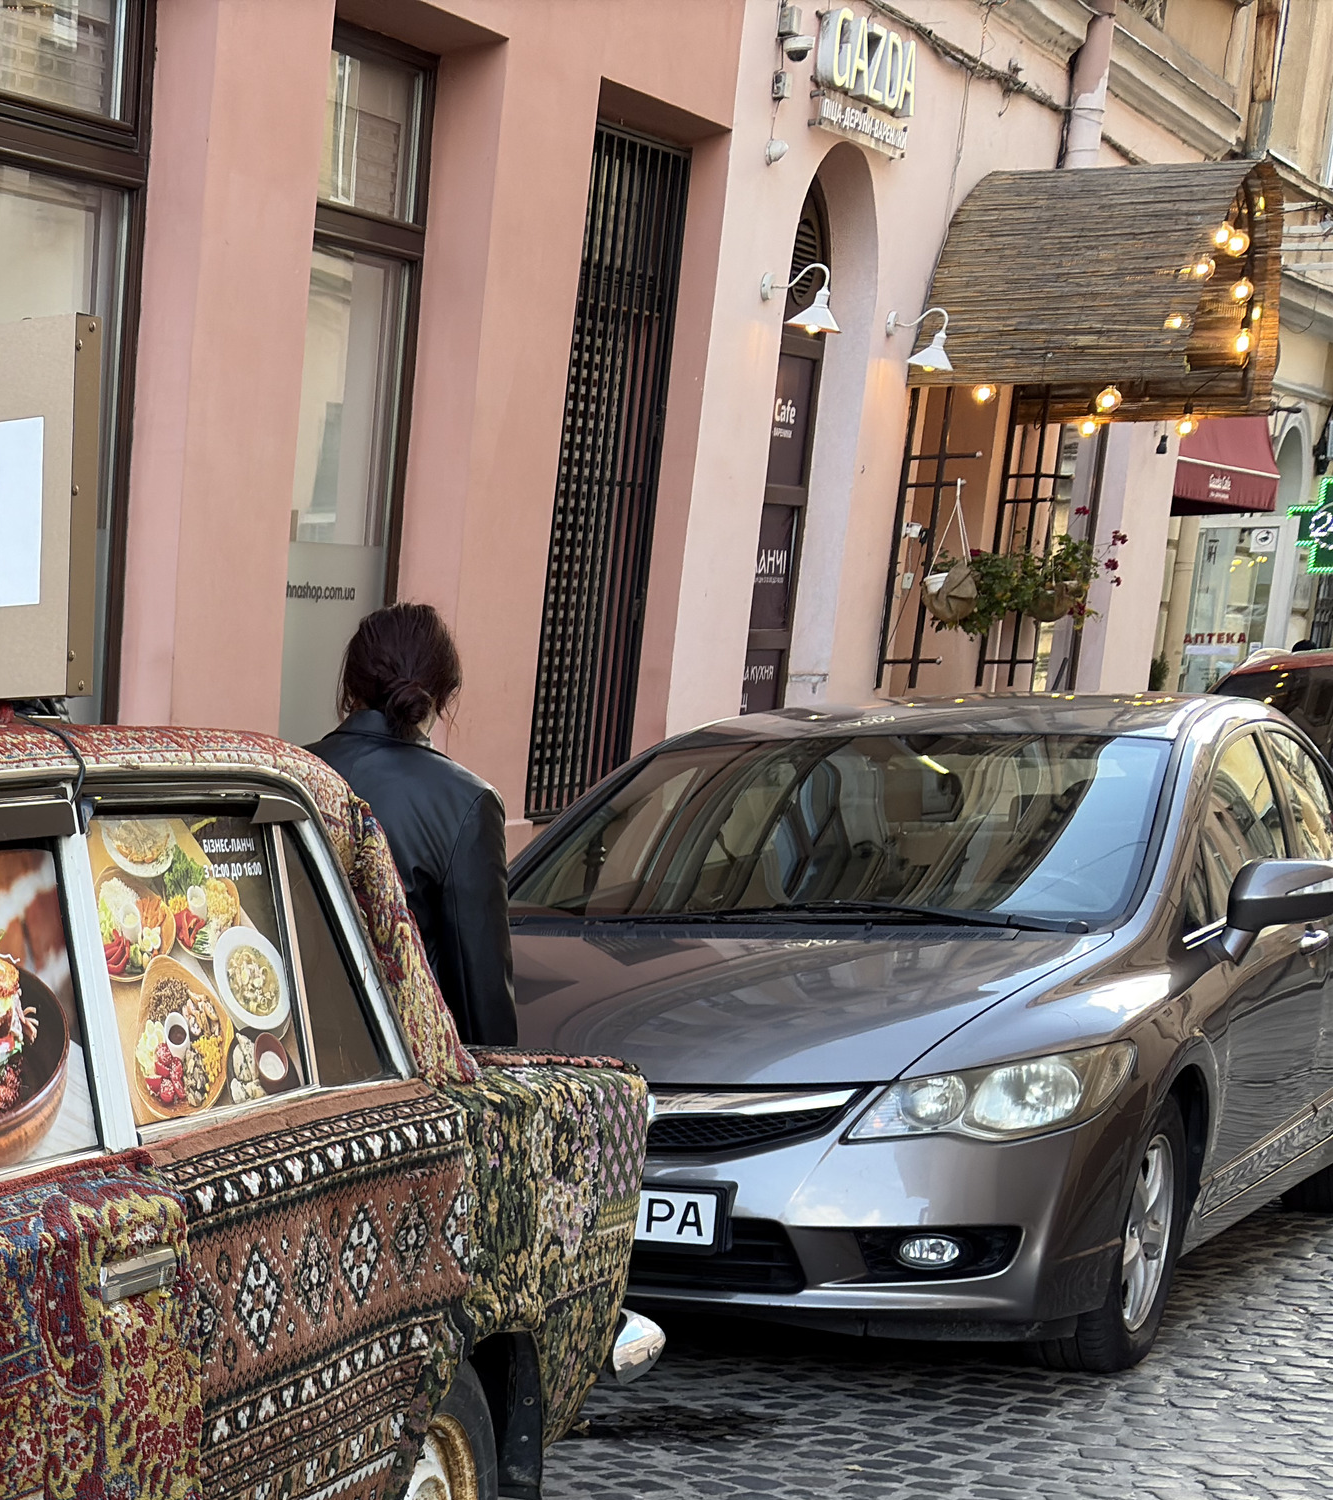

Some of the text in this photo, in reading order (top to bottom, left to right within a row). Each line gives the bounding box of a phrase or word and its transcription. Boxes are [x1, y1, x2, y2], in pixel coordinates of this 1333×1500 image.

[833, 7, 916, 117] GAZDA
[755, 549, 787, 575] АНЧІ
[1183, 632, 1247, 645] АПТЕКА
[750, 664, 774, 685] КУХНЯ
[202, 837, 255, 853] БІЗНЕС-ЛАНЧІ
[212, 863, 230, 878] 12:00
[231, 862, 243, 880] ДО
[244, 862, 263, 876] 16:00
